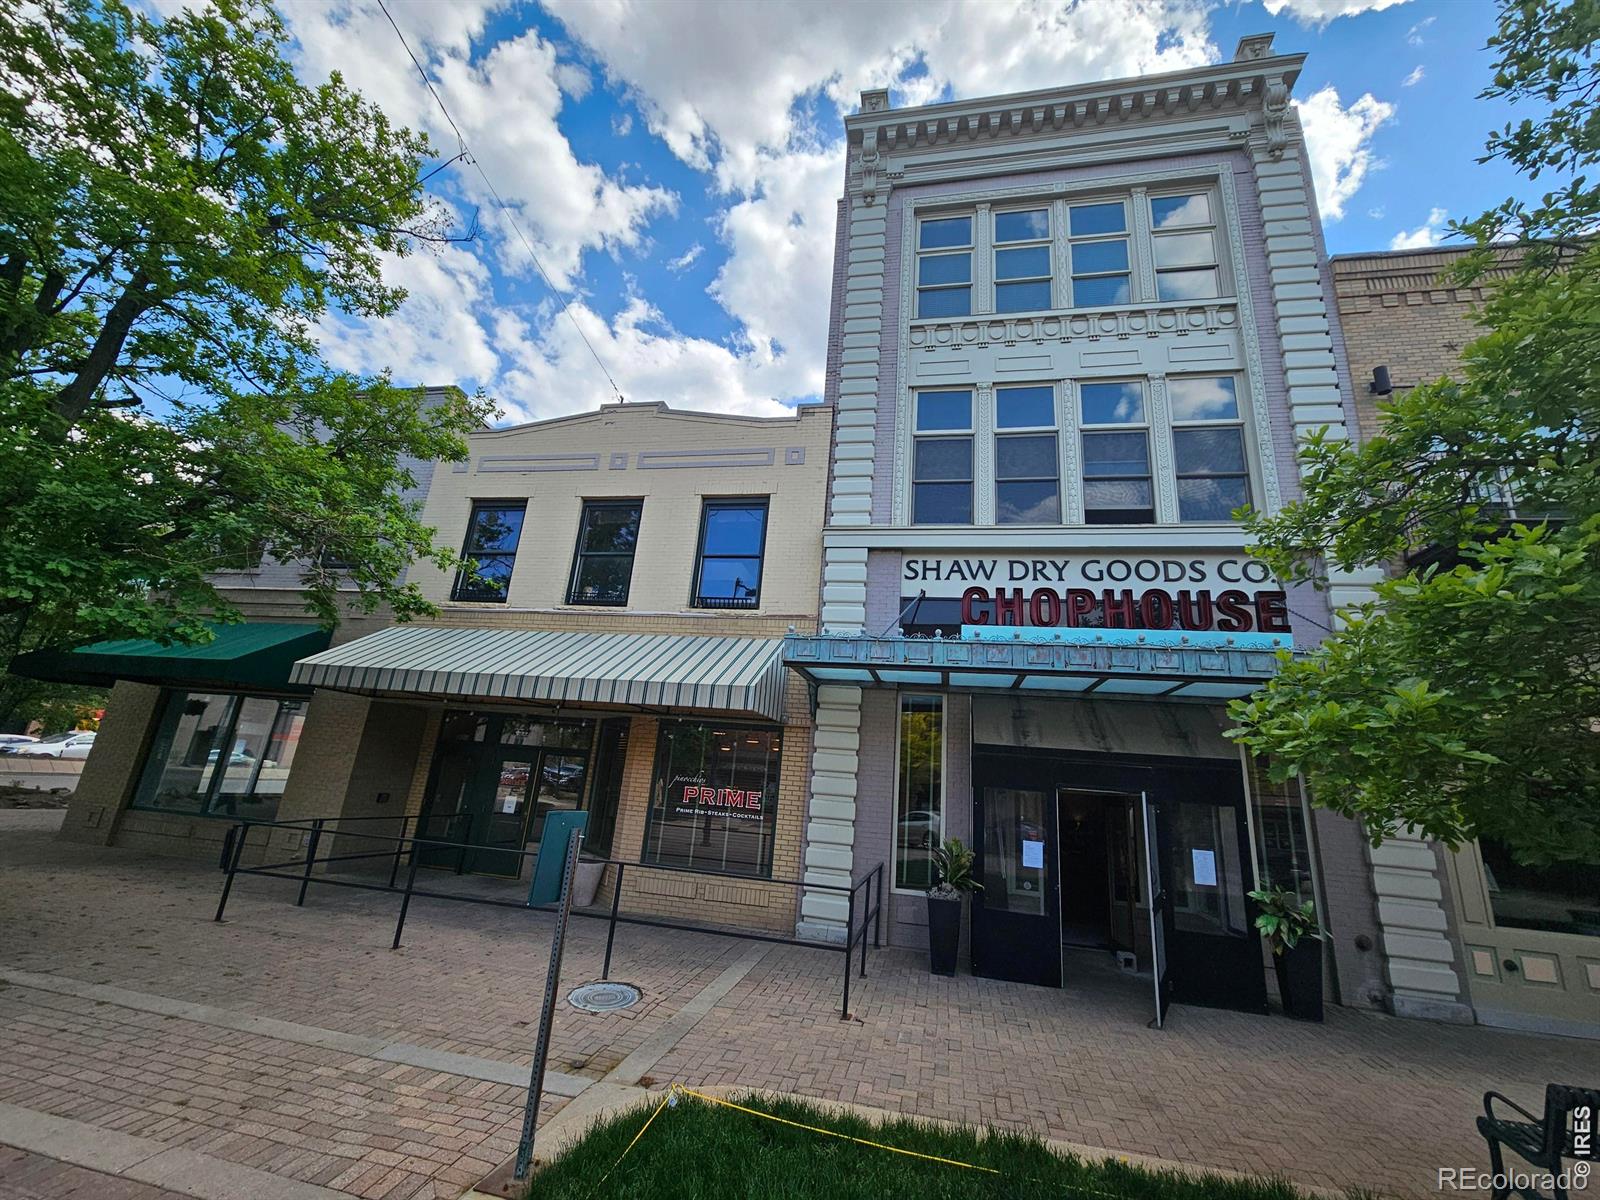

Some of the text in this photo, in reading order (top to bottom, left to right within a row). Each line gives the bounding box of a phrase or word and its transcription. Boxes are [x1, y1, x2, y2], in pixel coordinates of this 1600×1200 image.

[904, 559, 1277, 584] SHAW DRY GOODS CO.
[960, 586, 1293, 634] CHOPHOUSE
[682, 785, 762, 809] PRIME
